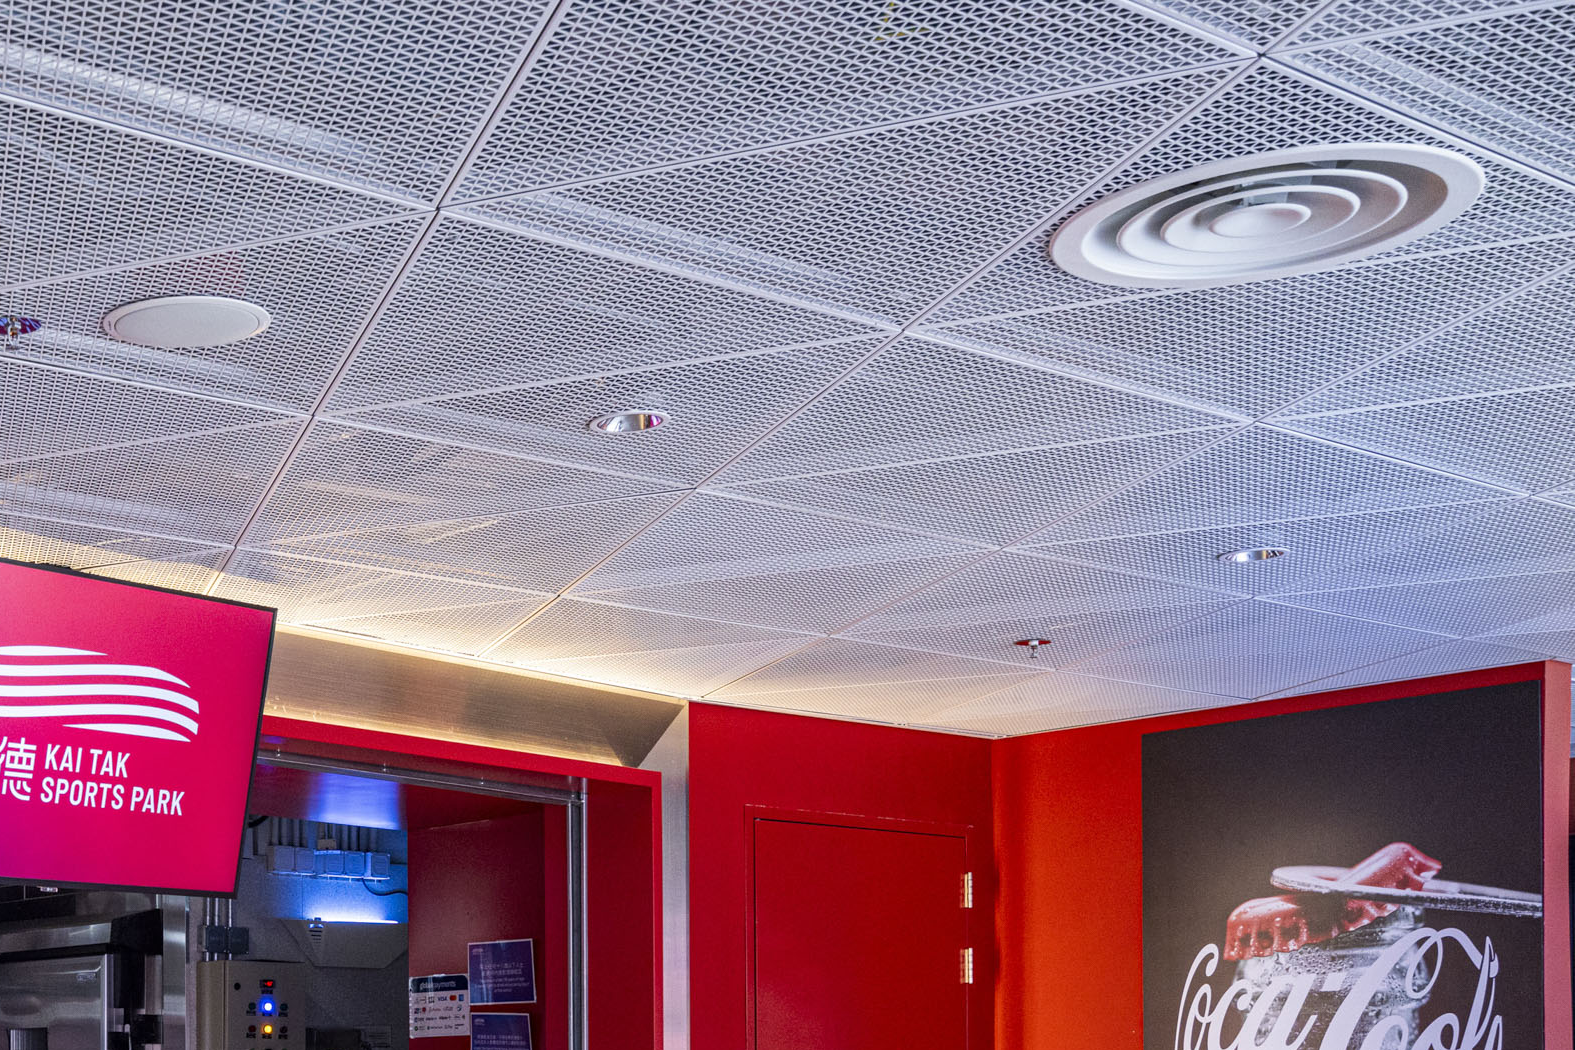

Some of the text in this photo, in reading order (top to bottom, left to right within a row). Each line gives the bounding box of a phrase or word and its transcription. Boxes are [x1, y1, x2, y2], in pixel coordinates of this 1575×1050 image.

[44, 743, 131, 778] KAI TAK
[40, 776, 186, 816] SPORTS PARK
